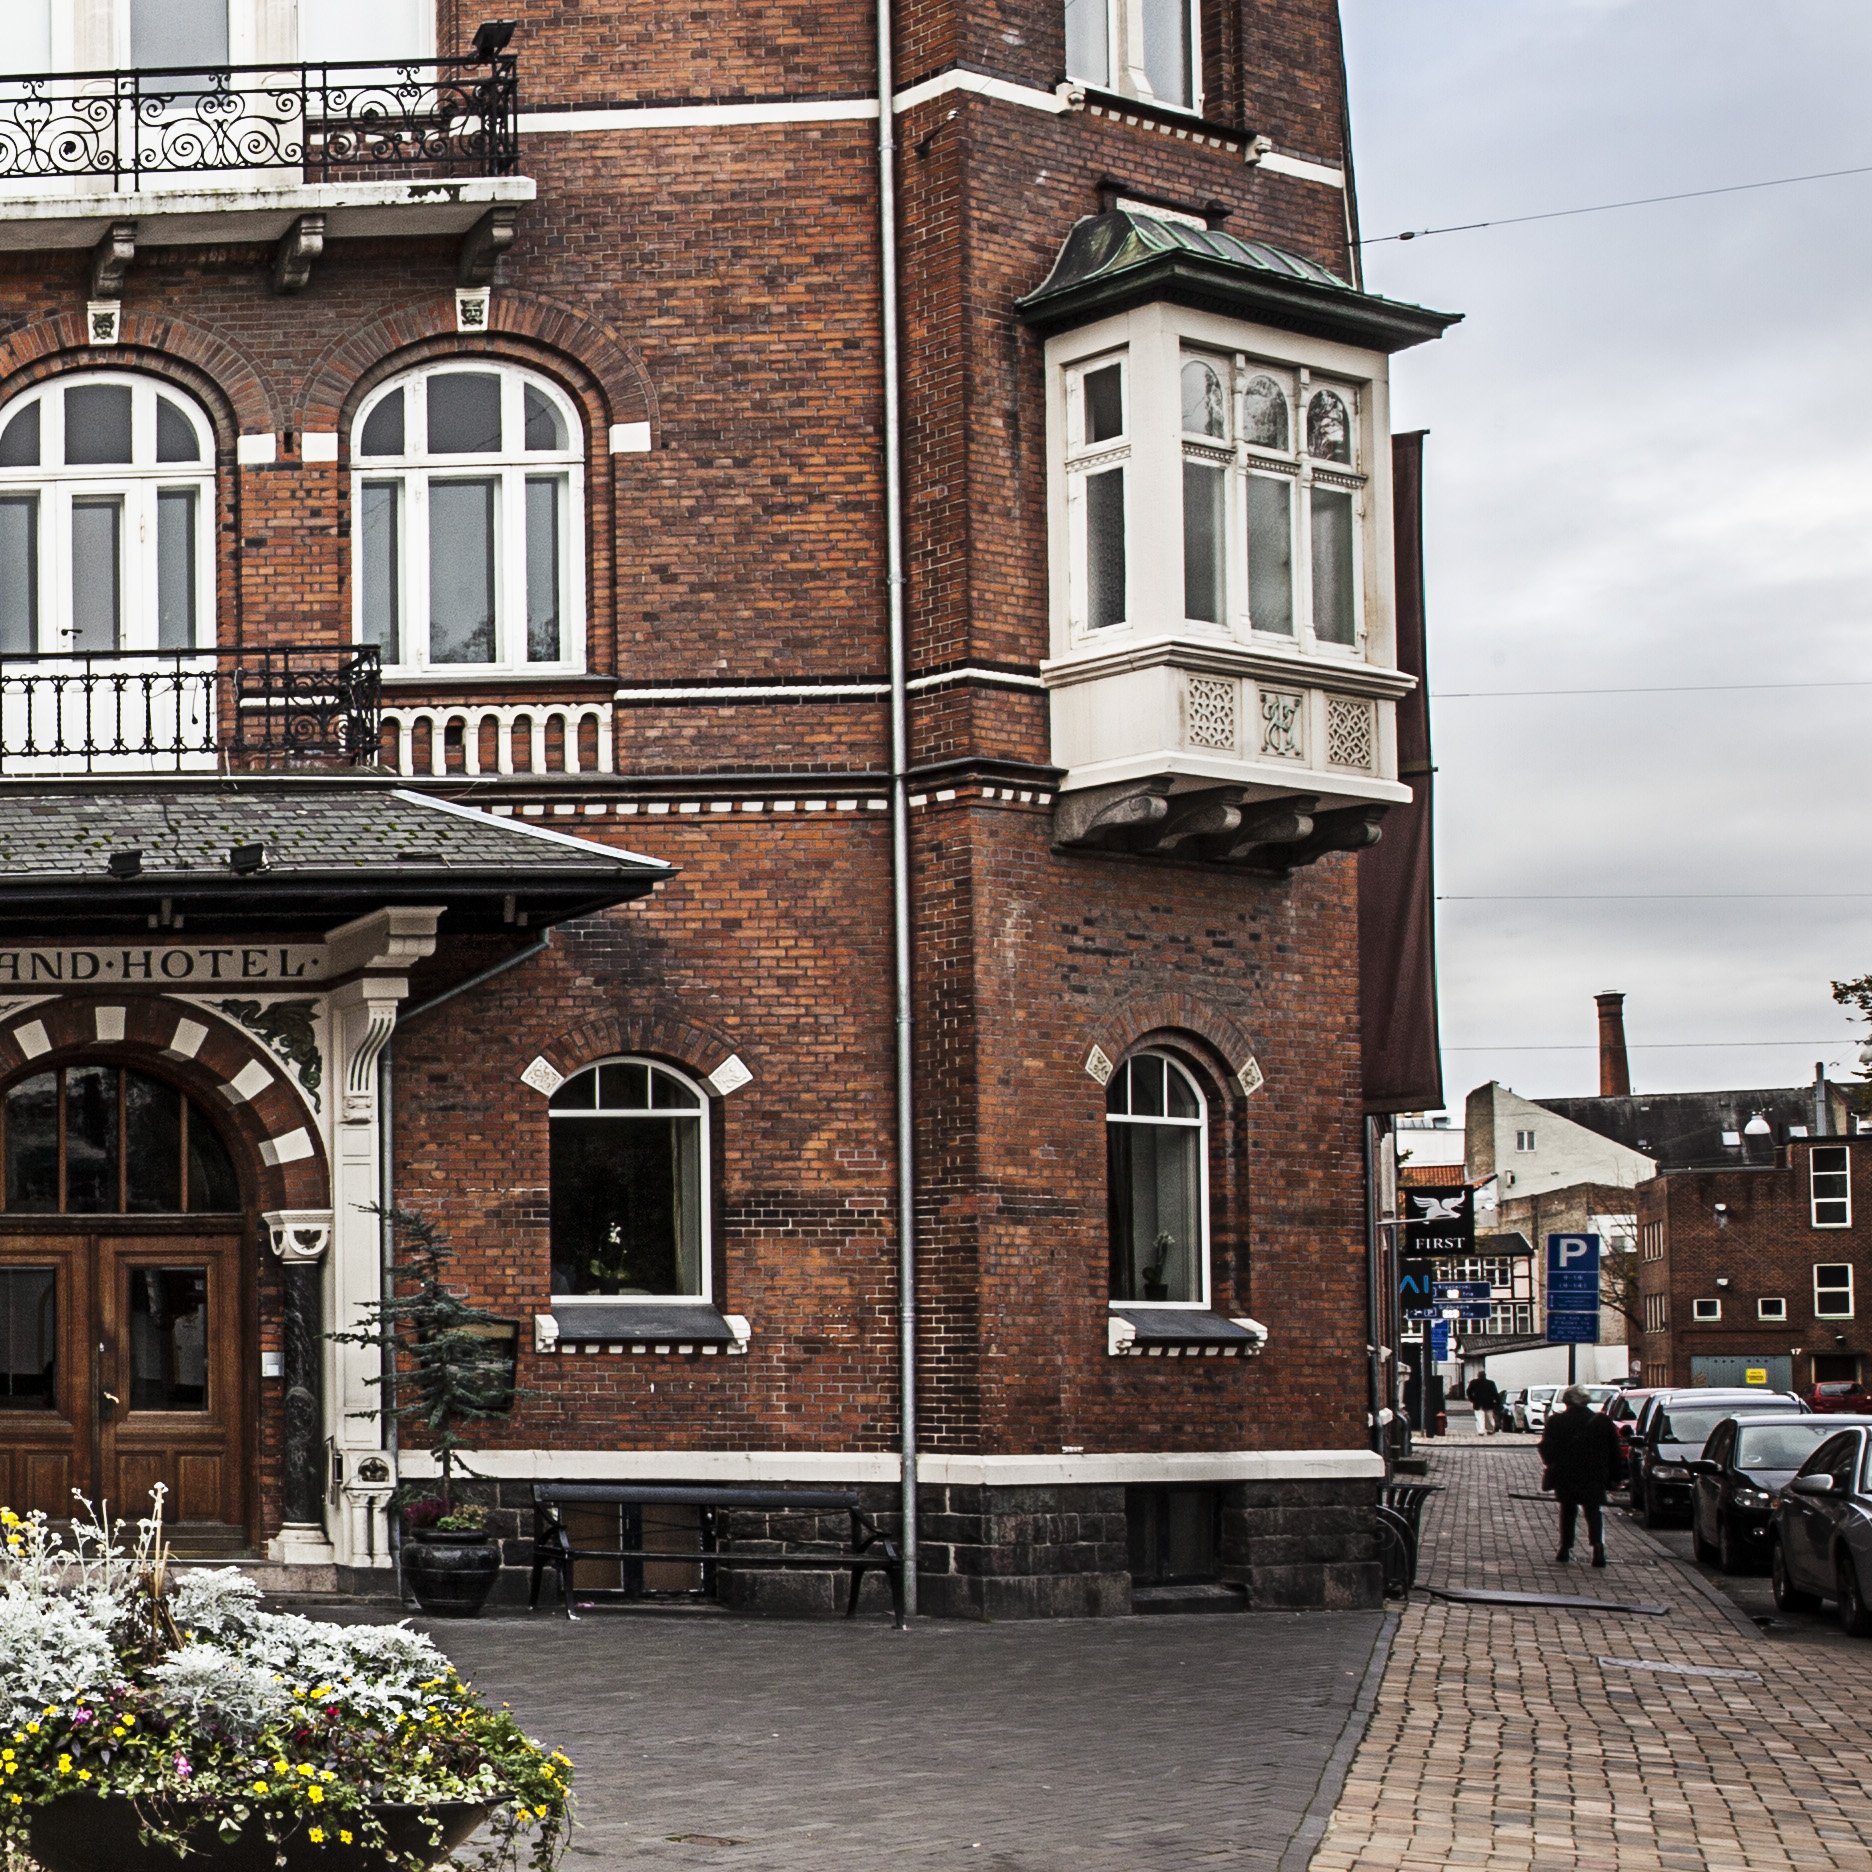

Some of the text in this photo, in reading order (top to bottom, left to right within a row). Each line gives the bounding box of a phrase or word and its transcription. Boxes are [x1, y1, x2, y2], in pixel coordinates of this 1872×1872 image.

[123, 949, 304, 980] HOTEL
[1415, 1237, 1466, 1251] FIRST
[1559, 1238, 1588, 1268] P
